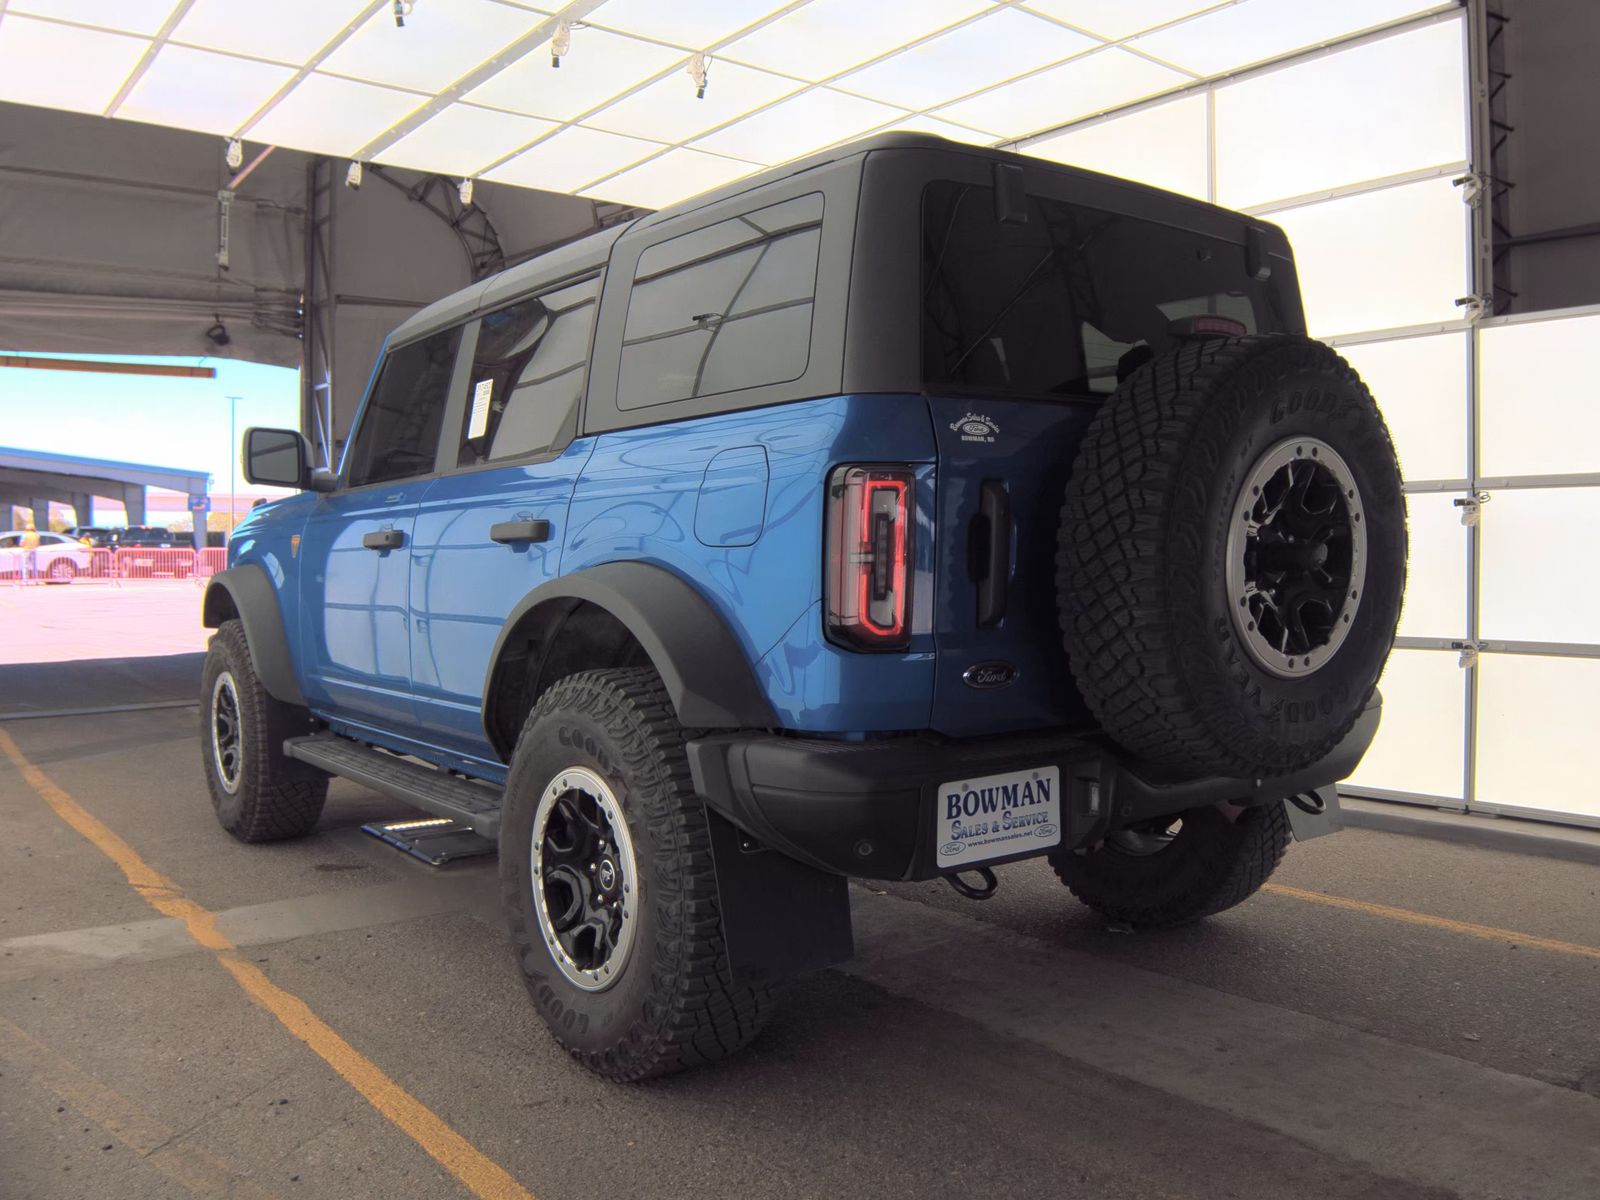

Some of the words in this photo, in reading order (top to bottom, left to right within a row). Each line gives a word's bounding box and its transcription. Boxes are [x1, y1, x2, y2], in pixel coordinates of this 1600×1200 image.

[976, 669, 1008, 683] Ford
[946, 778, 1051, 820] BOWMAN
[951, 820, 988, 840] SALES
[991, 821, 1000, 833] &
[1002, 810, 1049, 831] SERVICE
[967, 830, 1033, 848] www.bowmansales.net
